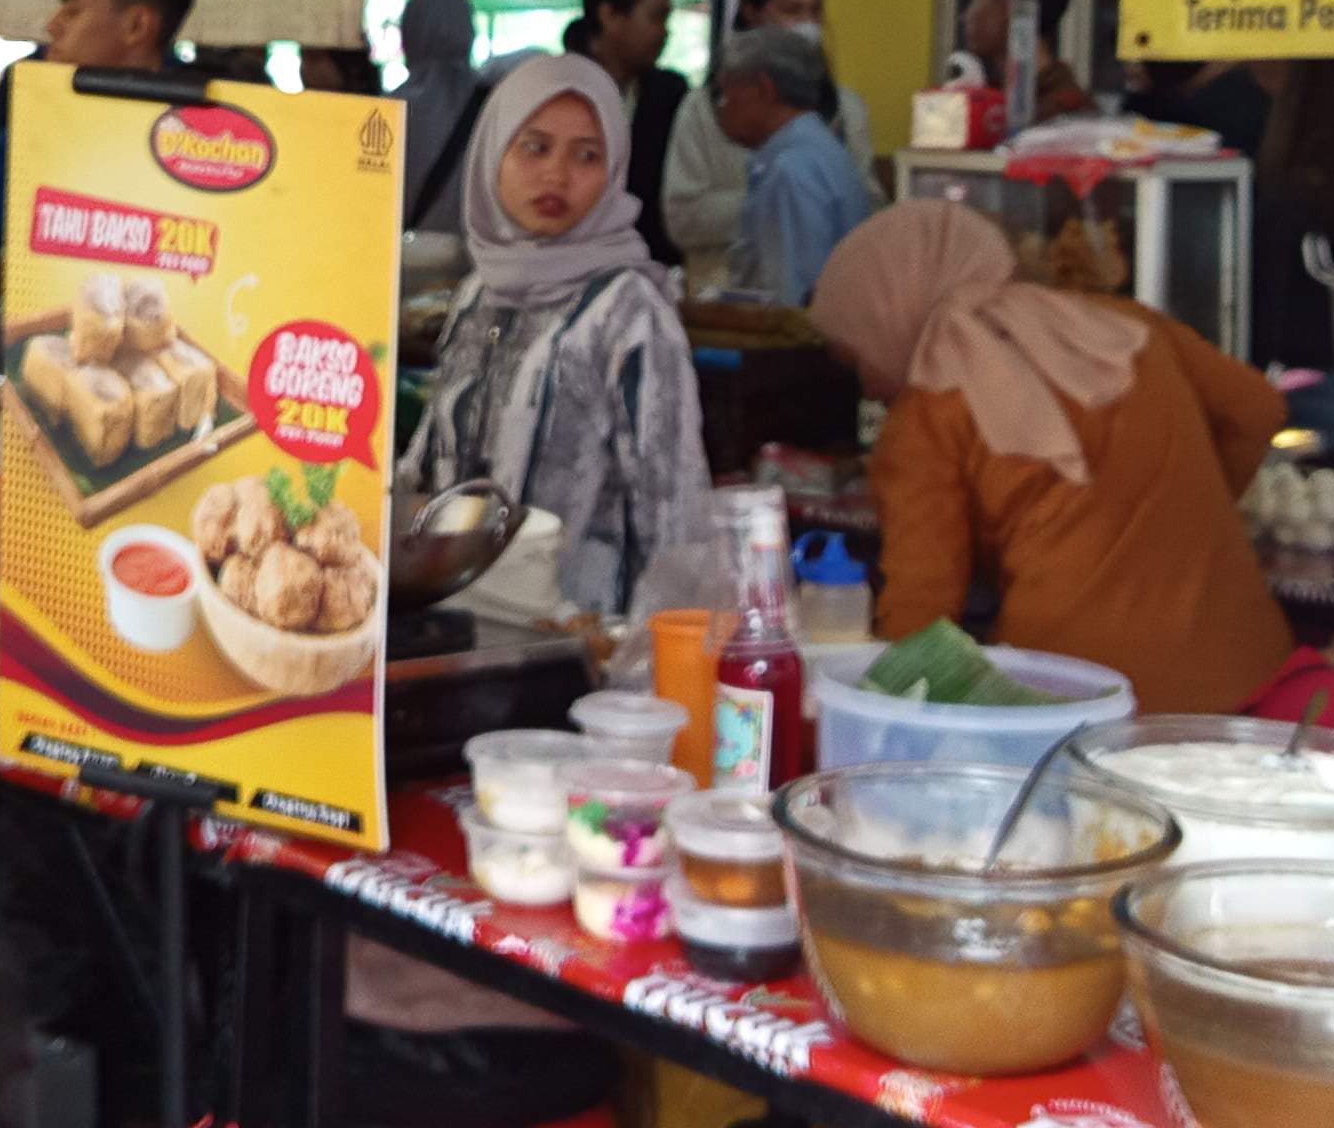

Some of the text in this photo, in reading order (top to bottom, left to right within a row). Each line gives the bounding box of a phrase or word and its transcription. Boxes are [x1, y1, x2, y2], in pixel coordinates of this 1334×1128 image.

[39, 202, 216, 256] TAHU BAKSO 20K
[274, 332, 357, 373] BAKSO
[265, 362, 364, 408] GORENG
[276, 398, 348, 434] 20K
